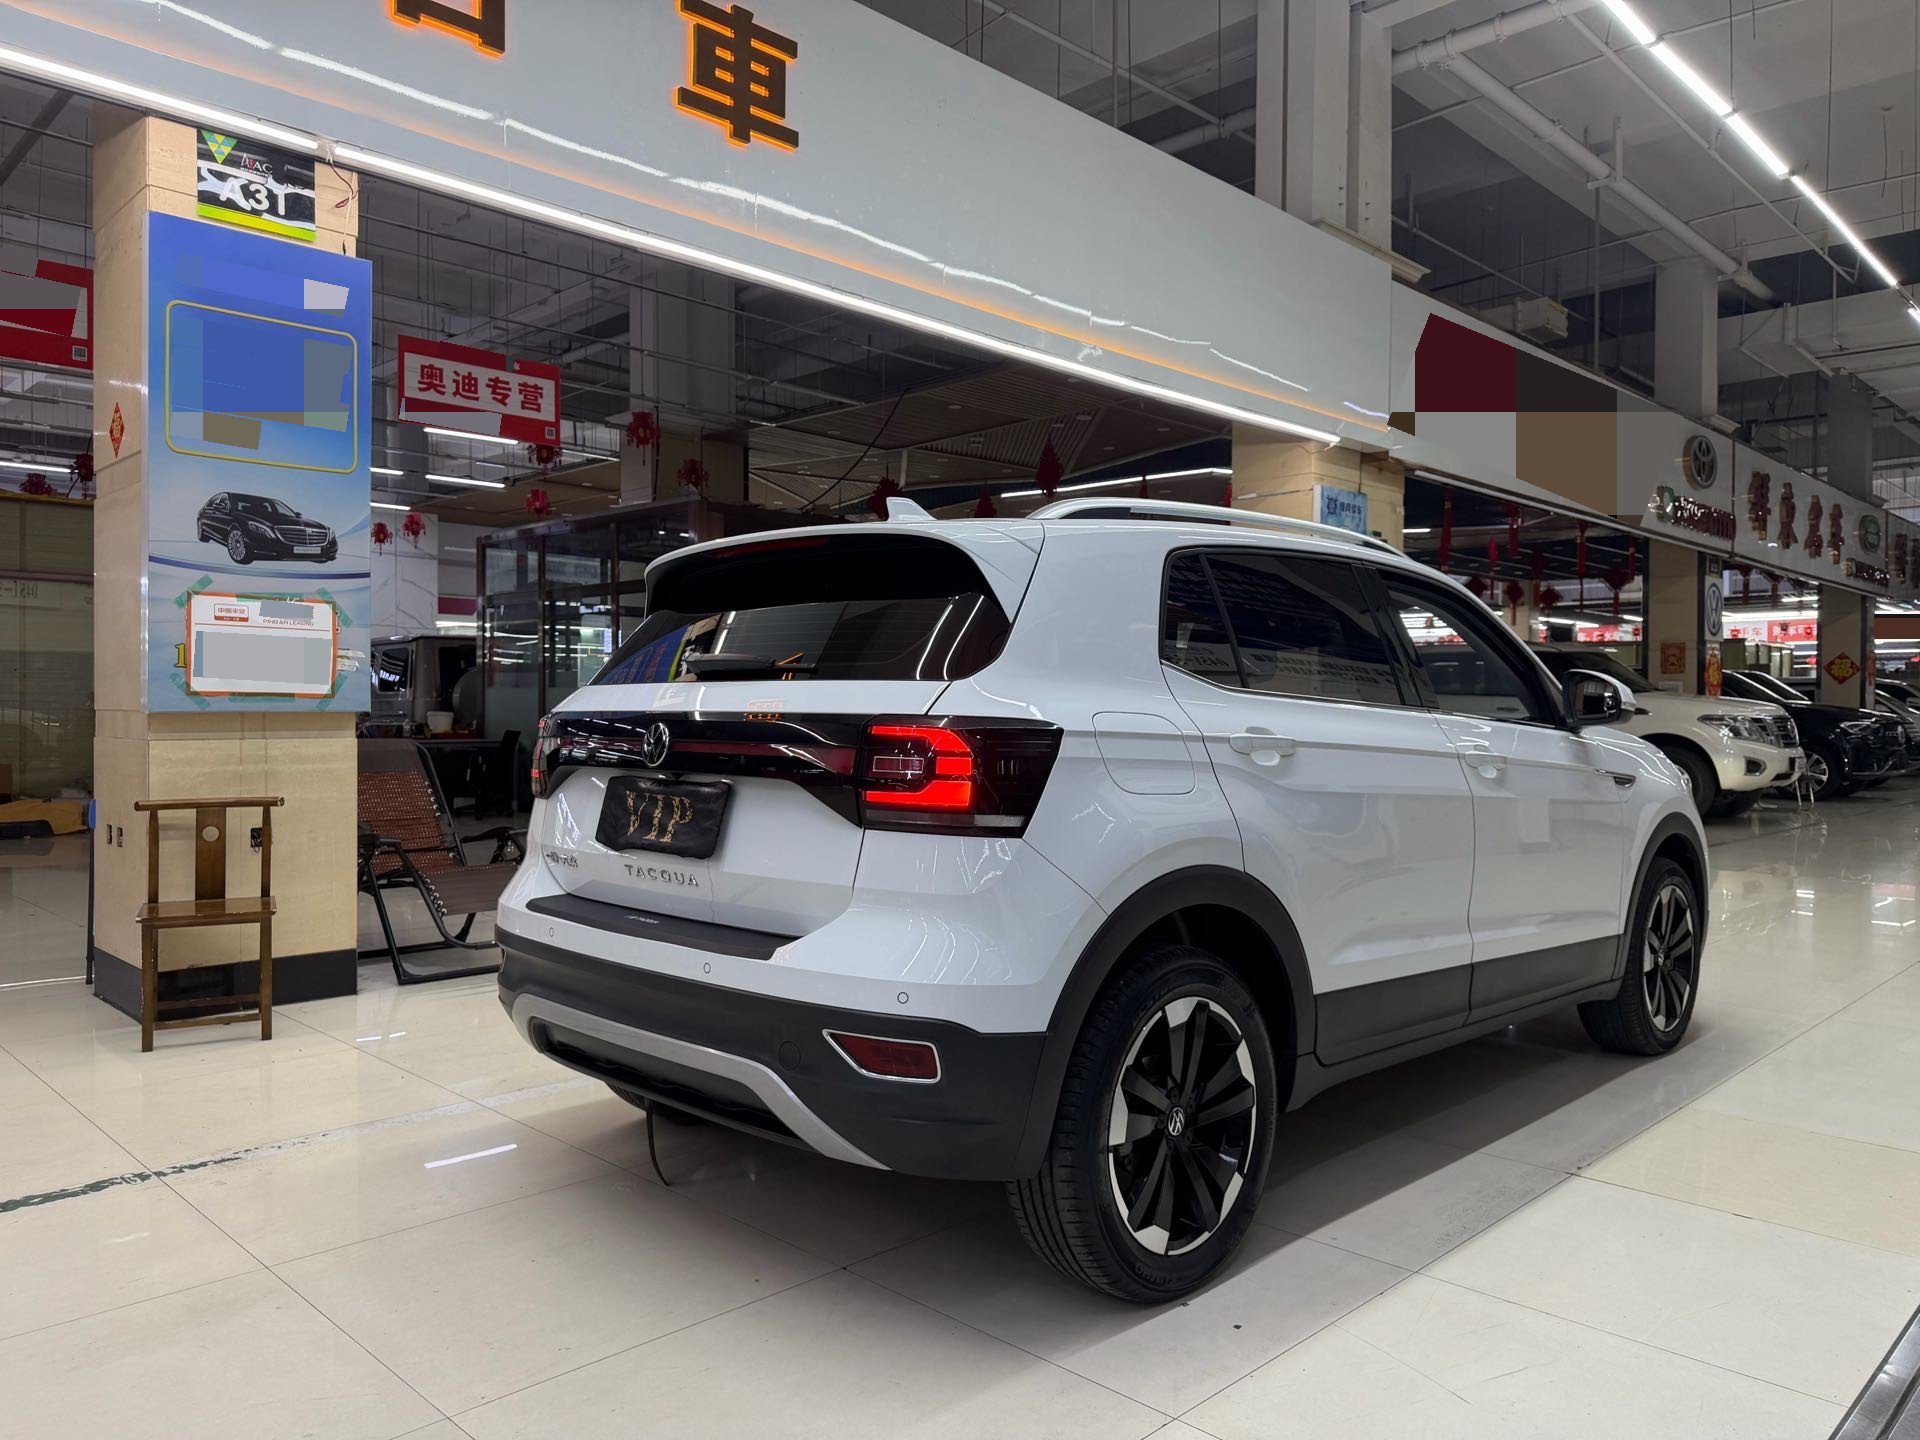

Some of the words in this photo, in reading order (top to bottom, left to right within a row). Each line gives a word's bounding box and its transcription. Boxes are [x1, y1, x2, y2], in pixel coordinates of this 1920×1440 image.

[417, 363, 544, 414] 奥迪专营
[626, 790, 694, 843] VIP
[624, 864, 699, 887] TACQUA
